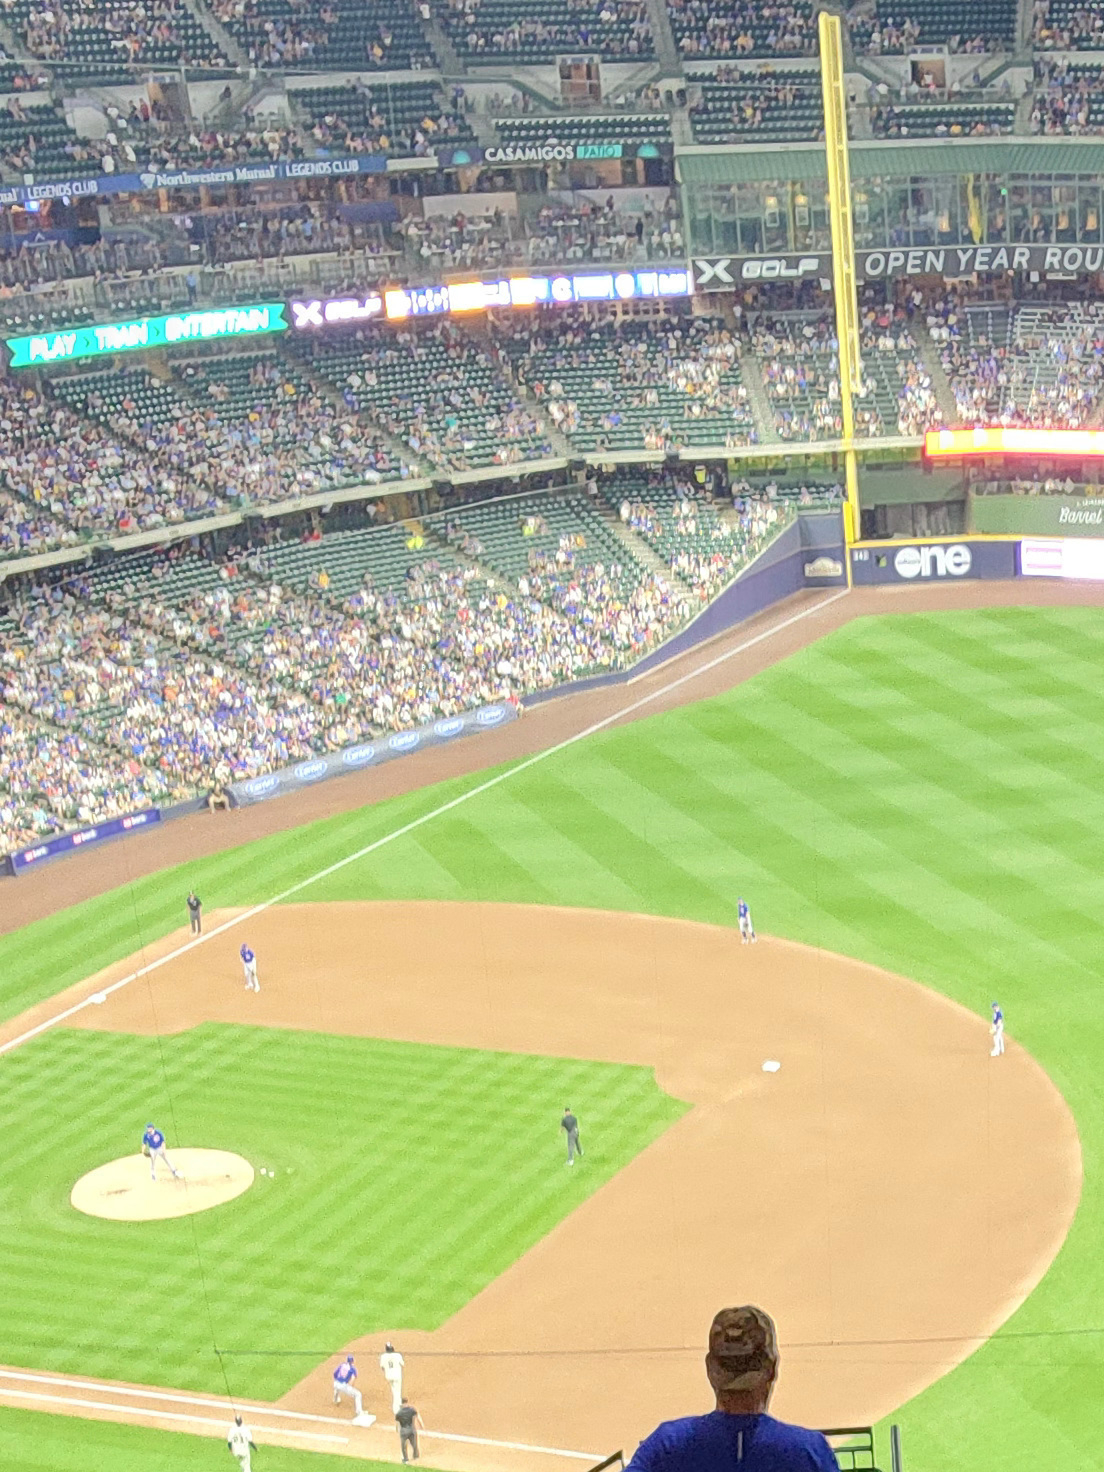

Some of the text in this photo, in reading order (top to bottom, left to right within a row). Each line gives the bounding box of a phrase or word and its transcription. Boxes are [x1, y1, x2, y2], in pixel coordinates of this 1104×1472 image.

[485, 145, 574, 161] CASAMIGOS
[286, 159, 359, 177] LEGENDS CLUB
[156, 171, 234, 188] Northwestern
[28, 180, 98, 199] LEGENDS CLUB
[742, 258, 818, 279] GOLF
[865, 250, 945, 275] OPEN
[957, 247, 1030, 271] YEAR
[29, 334, 76, 360] PLAY
[165, 309, 269, 341] ENTERTAIN
[1059, 506, 1103, 525] Barrel
[895, 543, 972, 579] one
